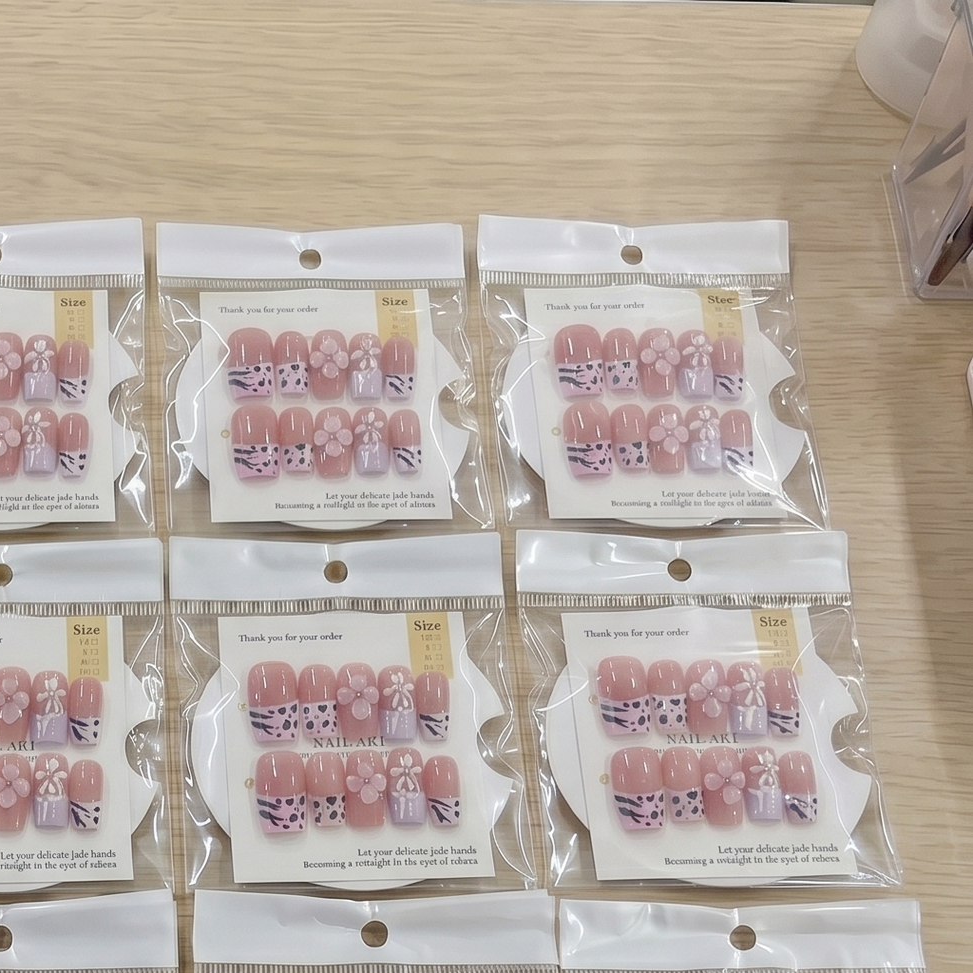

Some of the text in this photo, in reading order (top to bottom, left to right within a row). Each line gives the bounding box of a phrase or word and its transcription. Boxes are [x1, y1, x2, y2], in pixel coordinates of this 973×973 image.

[60, 298, 87, 308] Size
[382, 297, 409, 307] Size
[414, 620, 442, 633] Size
[759, 616, 788, 628] Size
[73, 624, 101, 636] Size
[238, 631, 344, 645] Thank you for your order
